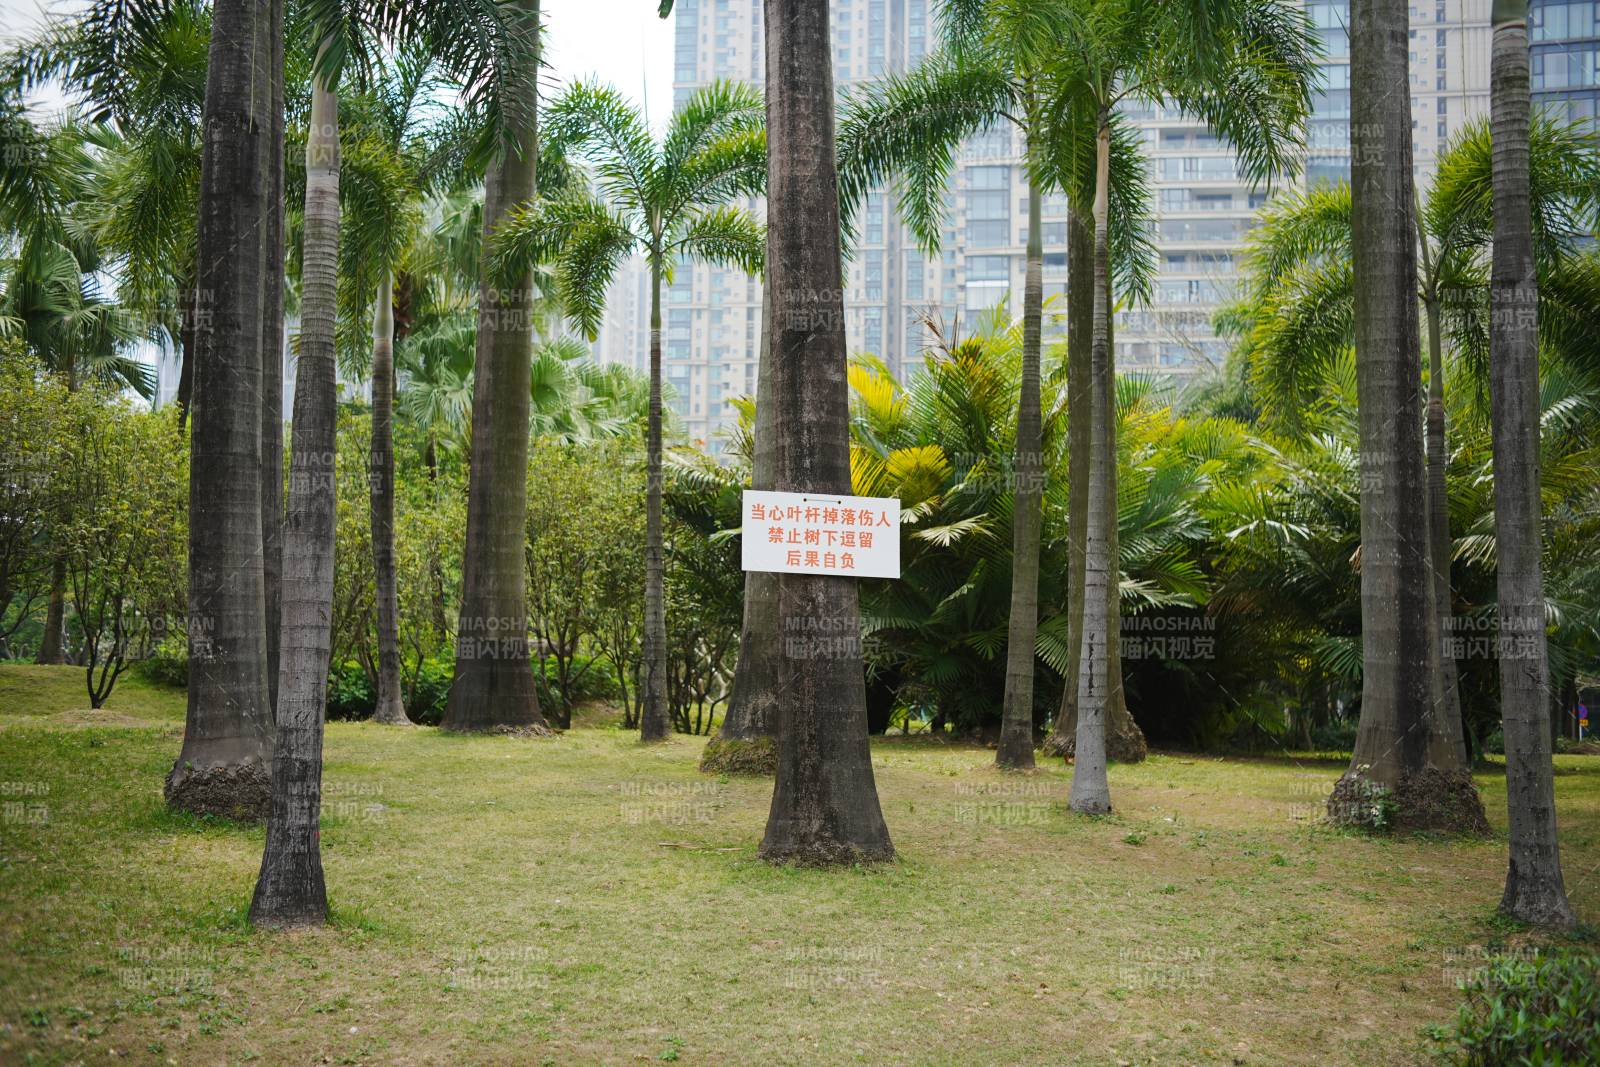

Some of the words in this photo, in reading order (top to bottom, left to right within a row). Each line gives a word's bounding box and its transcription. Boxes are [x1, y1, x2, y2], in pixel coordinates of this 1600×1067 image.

[752, 503, 891, 527] 当心叶杆掉落伤人
[768, 526, 873, 548] 禁止树下逗留
[786, 550, 855, 569] 后果自负
